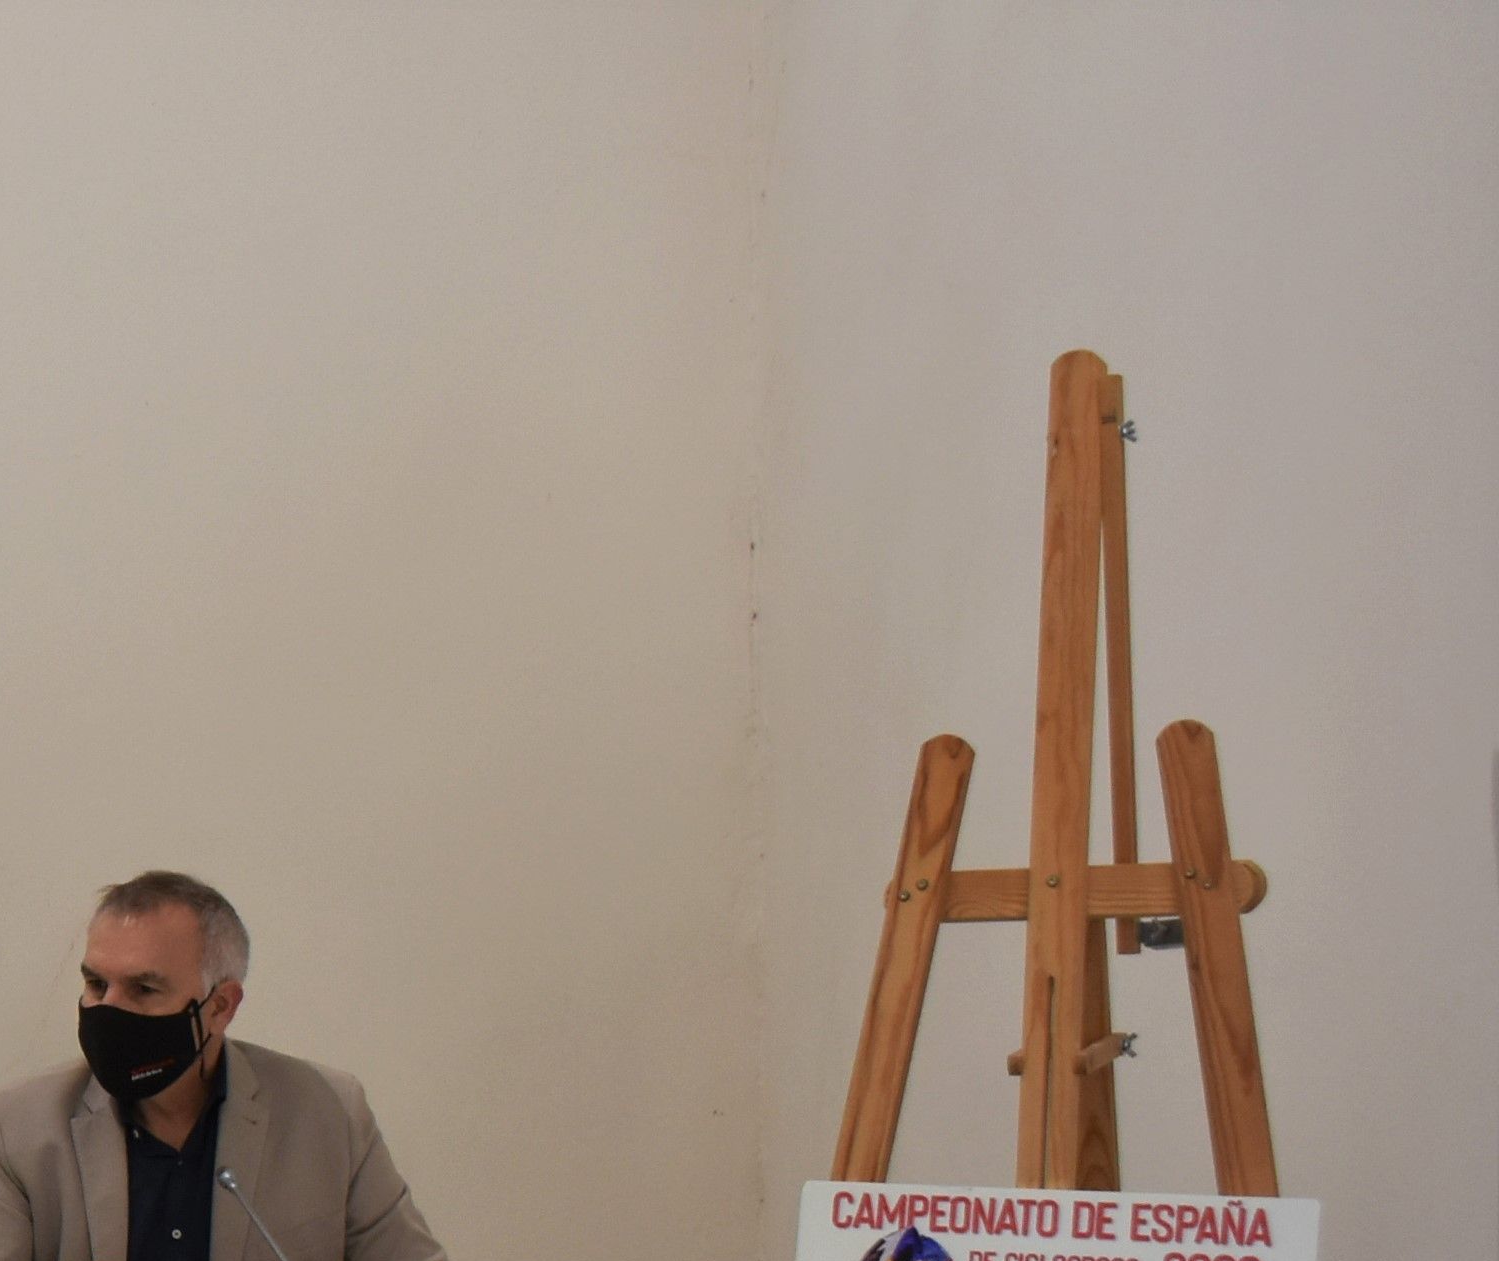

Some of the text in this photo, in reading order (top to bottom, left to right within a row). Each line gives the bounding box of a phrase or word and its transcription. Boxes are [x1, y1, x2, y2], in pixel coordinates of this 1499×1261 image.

[832, 1190, 1273, 1247] CAMPEONATO DE ESPAÑA
